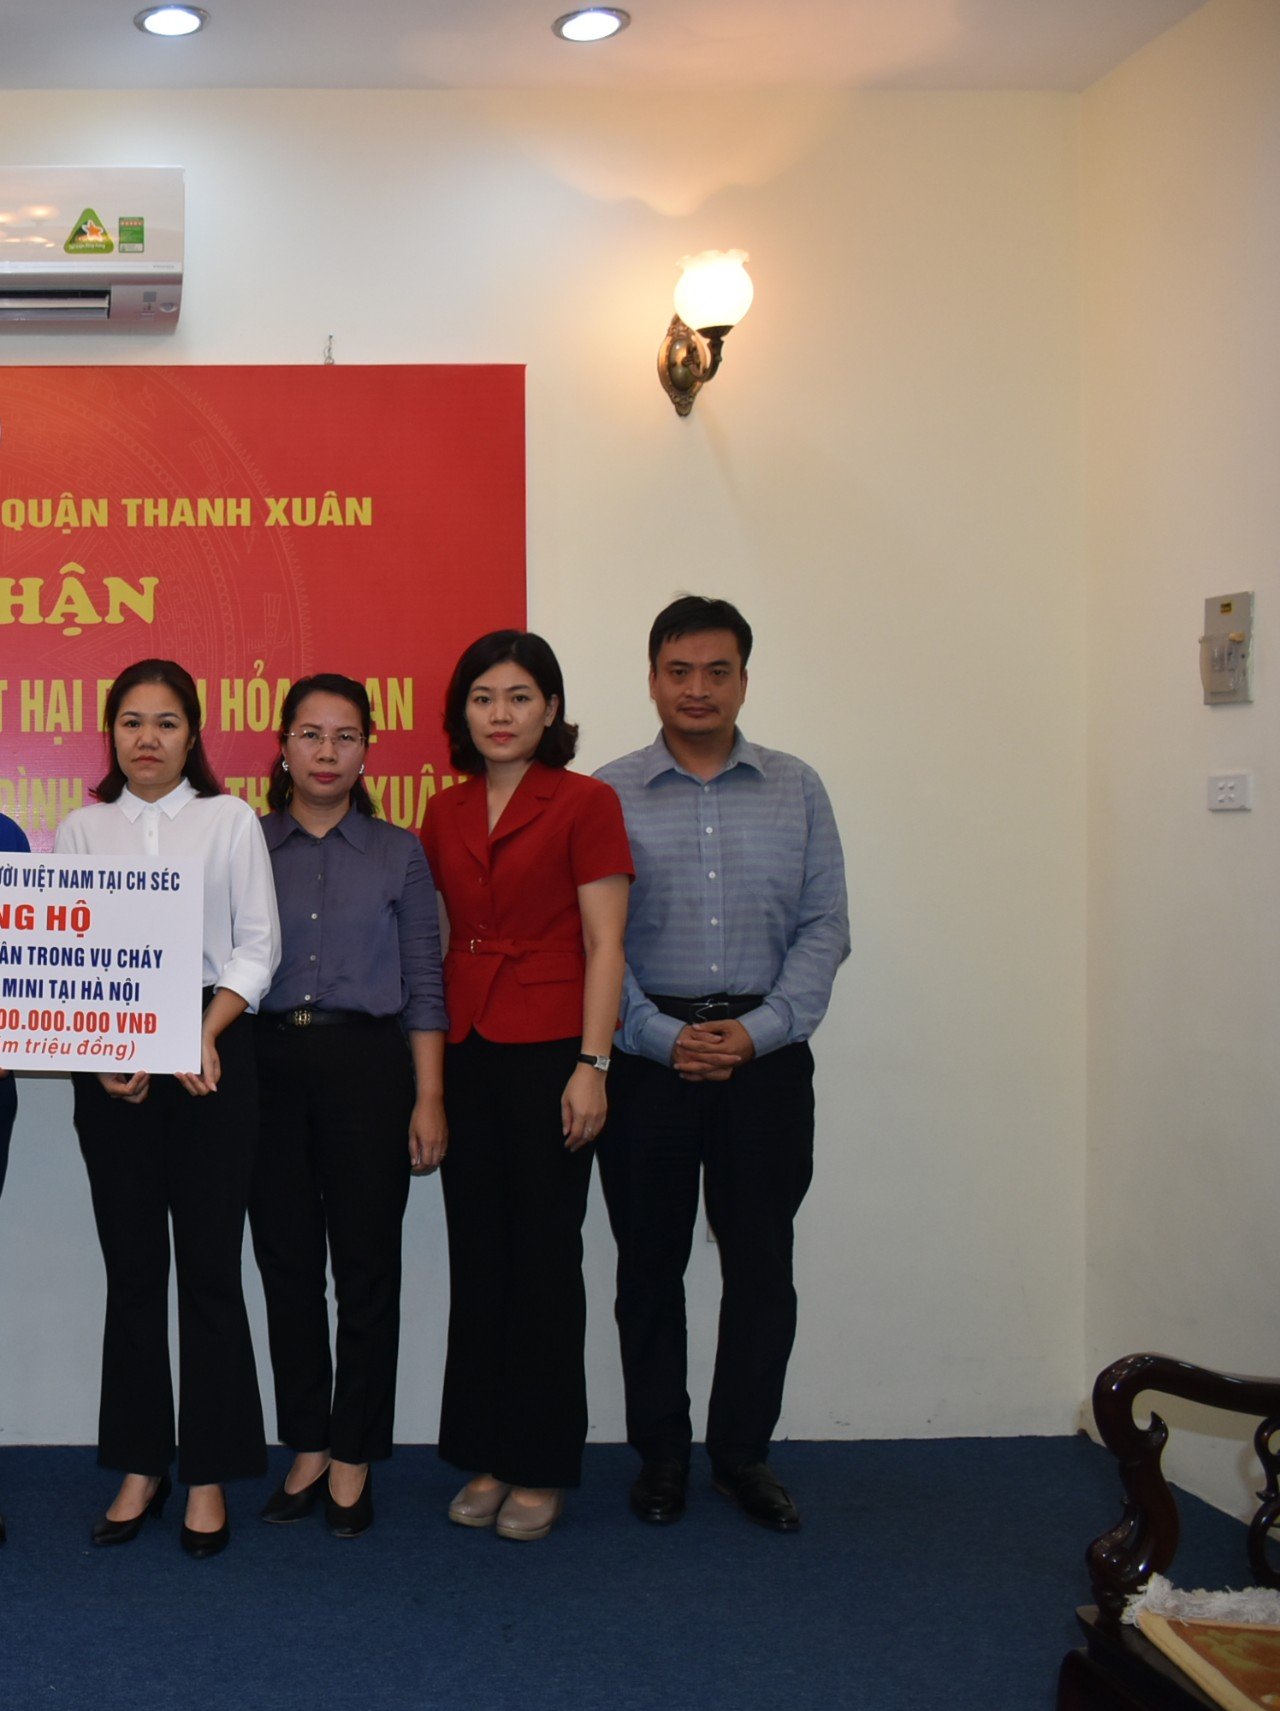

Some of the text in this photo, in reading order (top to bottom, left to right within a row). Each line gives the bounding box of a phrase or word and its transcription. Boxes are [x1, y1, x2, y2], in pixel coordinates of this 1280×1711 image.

[1, 492, 109, 535] QUẬN
[122, 497, 252, 528] THANH
[266, 490, 373, 527] XUÂN
[20, 679, 83, 745] HẠI
[363, 763, 468, 830] XUÂ
[22, 864, 55, 893] VIỆT
[58, 869, 94, 890] NAM
[98, 870, 122, 895] TẠI
[126, 871, 146, 891] CH
[150, 868, 180, 892] SÉC
[46, 899, 92, 938] HỘ
[27, 945, 85, 968] TRONG
[90, 948, 113, 972] VỤ
[117, 944, 163, 969] CHÁY
[2, 977, 45, 999] MINI
[48, 979, 77, 1004] TẠI
[81, 976, 104, 1001] HÀ
[108, 977, 141, 1006] NỘI
[116, 1011, 158, 1035] VNĐ
[25, 1037, 72, 1059] triệu
[76, 1035, 137, 1061] đồng)
